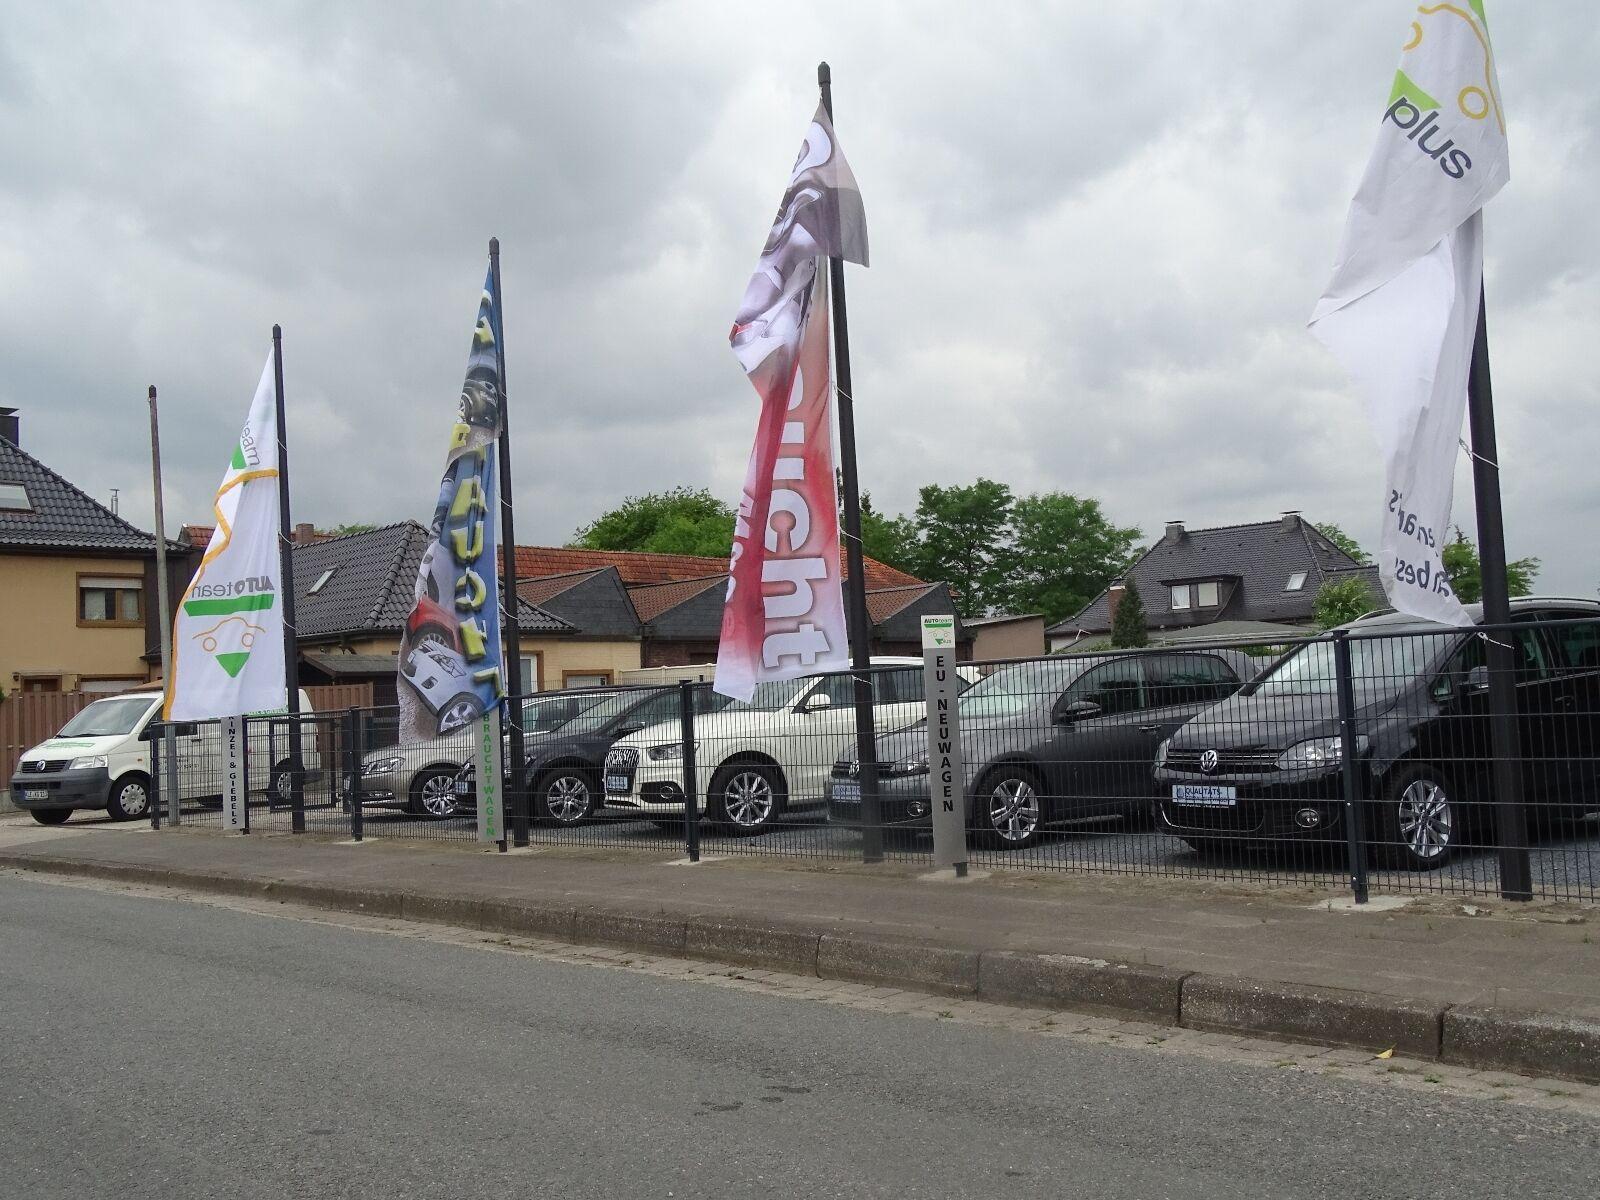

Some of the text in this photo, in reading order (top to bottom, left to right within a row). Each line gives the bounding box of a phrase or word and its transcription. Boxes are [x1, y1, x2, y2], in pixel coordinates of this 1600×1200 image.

[1381, 96, 1472, 179] plus
[229, 772, 238, 825] GIEBELS
[482, 713, 495, 836] BRAUCHTWAGEN
